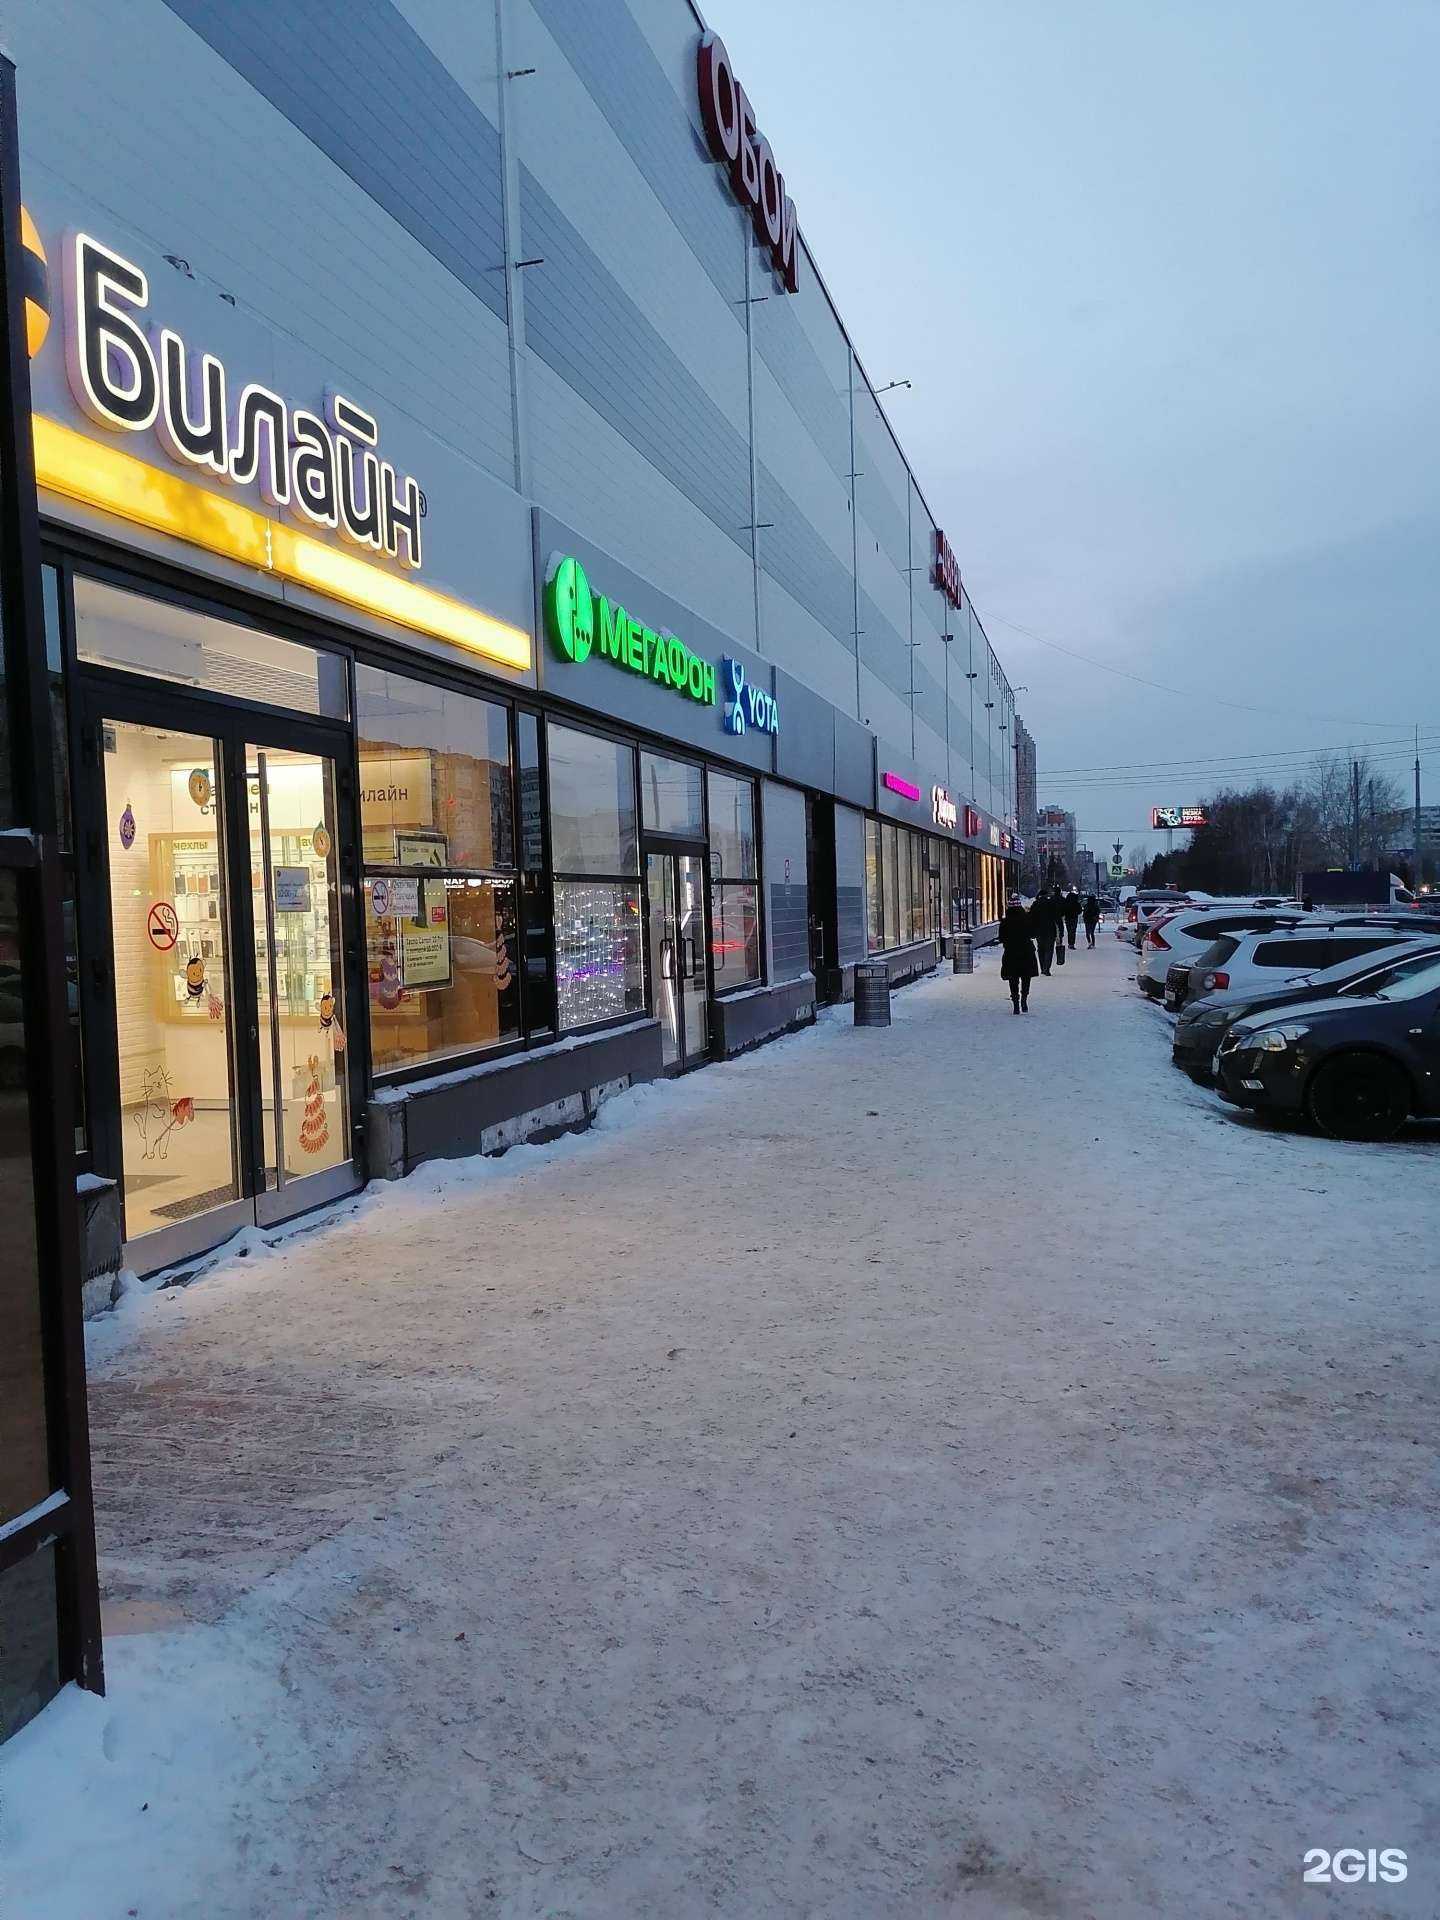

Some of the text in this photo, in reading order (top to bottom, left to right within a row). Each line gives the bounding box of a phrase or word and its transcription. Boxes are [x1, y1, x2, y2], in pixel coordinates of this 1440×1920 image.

[698, 30, 800, 294] ОБОИ
[72, 232, 423, 570] Билайн
[598, 594, 716, 706] МЕГАФОН
[747, 684, 780, 736] YOTA
